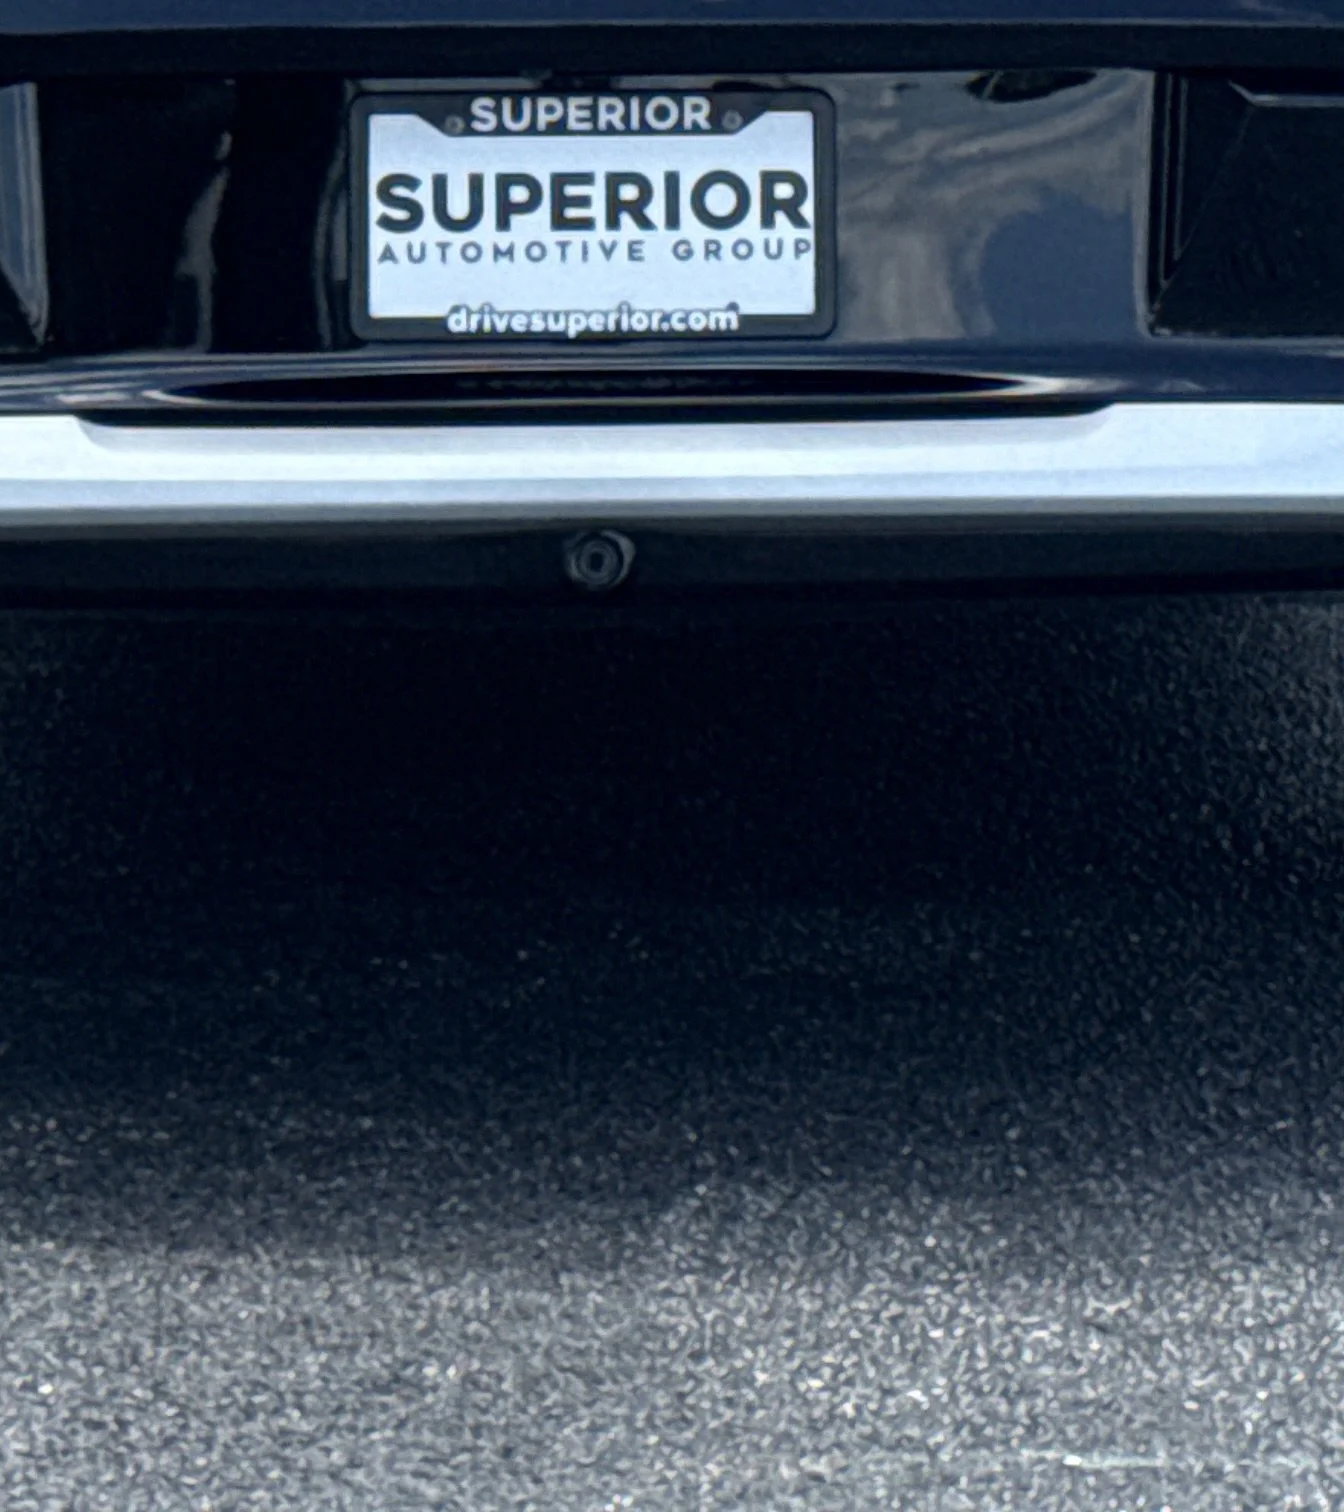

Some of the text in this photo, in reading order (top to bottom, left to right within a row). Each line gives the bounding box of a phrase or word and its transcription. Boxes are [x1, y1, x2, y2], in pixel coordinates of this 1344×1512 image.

[470, 95, 712, 133] SUPERIOR
[375, 169, 811, 234] SUPERIOR
[377, 237, 812, 266] AUTOMOTIVE GROUP
[447, 302, 740, 338] drivesuperior.com
